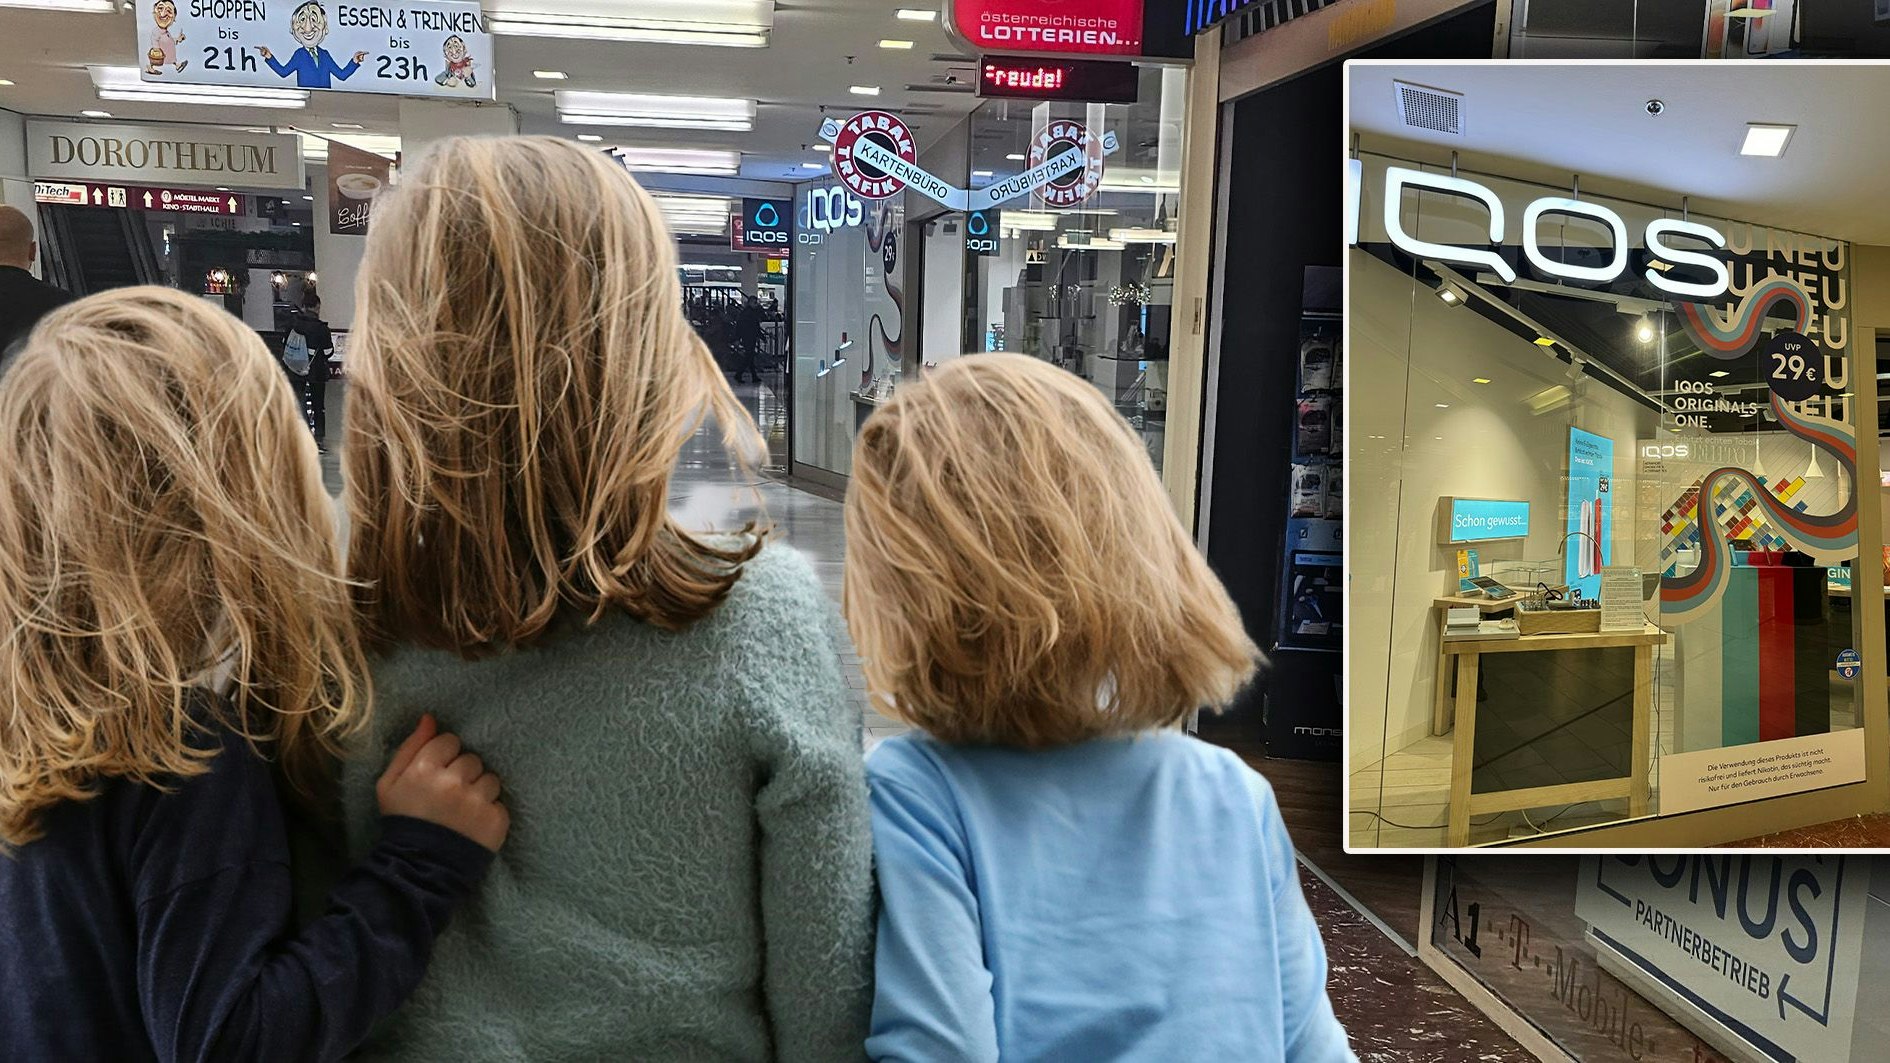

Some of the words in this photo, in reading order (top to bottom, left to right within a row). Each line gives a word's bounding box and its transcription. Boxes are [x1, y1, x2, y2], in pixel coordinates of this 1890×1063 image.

[190, 0, 266, 21] SHOPPEN
[338, 5, 391, 28] ESSEN
[396, 9, 407, 29] &
[410, 10, 484, 33] TRINKEN
[980, 11, 1117, 29] österreichische
[218, 26, 239, 40] bis
[389, 36, 410, 49] bis
[203, 46, 257, 73] 21h
[376, 55, 428, 82] 23h
[847, 115, 913, 155] TABAK
[49, 135, 278, 174] DOROTHEUM
[837, 145, 898, 196] TRAFIK
[860, 143, 948, 199] KARTENBÜRO
[806, 185, 862, 234] IQOS
[746, 230, 788, 243] IQOS
[1349, 159, 1730, 298] IQOS
[1784, 342, 1802, 352] UVP
[1771, 352, 1817, 382] 29€
[1674, 379, 1714, 396] IQOS
[1674, 397, 1759, 415] ORIGINALS
[1674, 414, 1713, 429] ONE.
[1641, 444, 1689, 460] IQOS
[1455, 514, 1486, 528] Schon
[1698, 772, 1725, 784] risikofrei
[1725, 771, 1737, 780] und
[1738, 769, 1756, 780] liefert
[1780, 763, 1791, 771] das
[1791, 760, 1813, 770] süchtig
[1707, 764, 1718, 772] Die
[1719, 759, 1756, 770] Verwendung
[1756, 756, 1775, 764] dieses
[1775, 752, 1801, 762] Produkts
[1809, 748, 1824, 757] nicht
[1708, 785, 1720, 793] Nur
[1720, 783, 1730, 791] für
[1731, 780, 1743, 790] den
[1743, 775, 1773, 787] Gebrauch
[1773, 773, 1790, 782] durch
[1439, 885, 1482, 959] A1
[1635, 899, 1771, 1000] PARTNERBETRIEB
